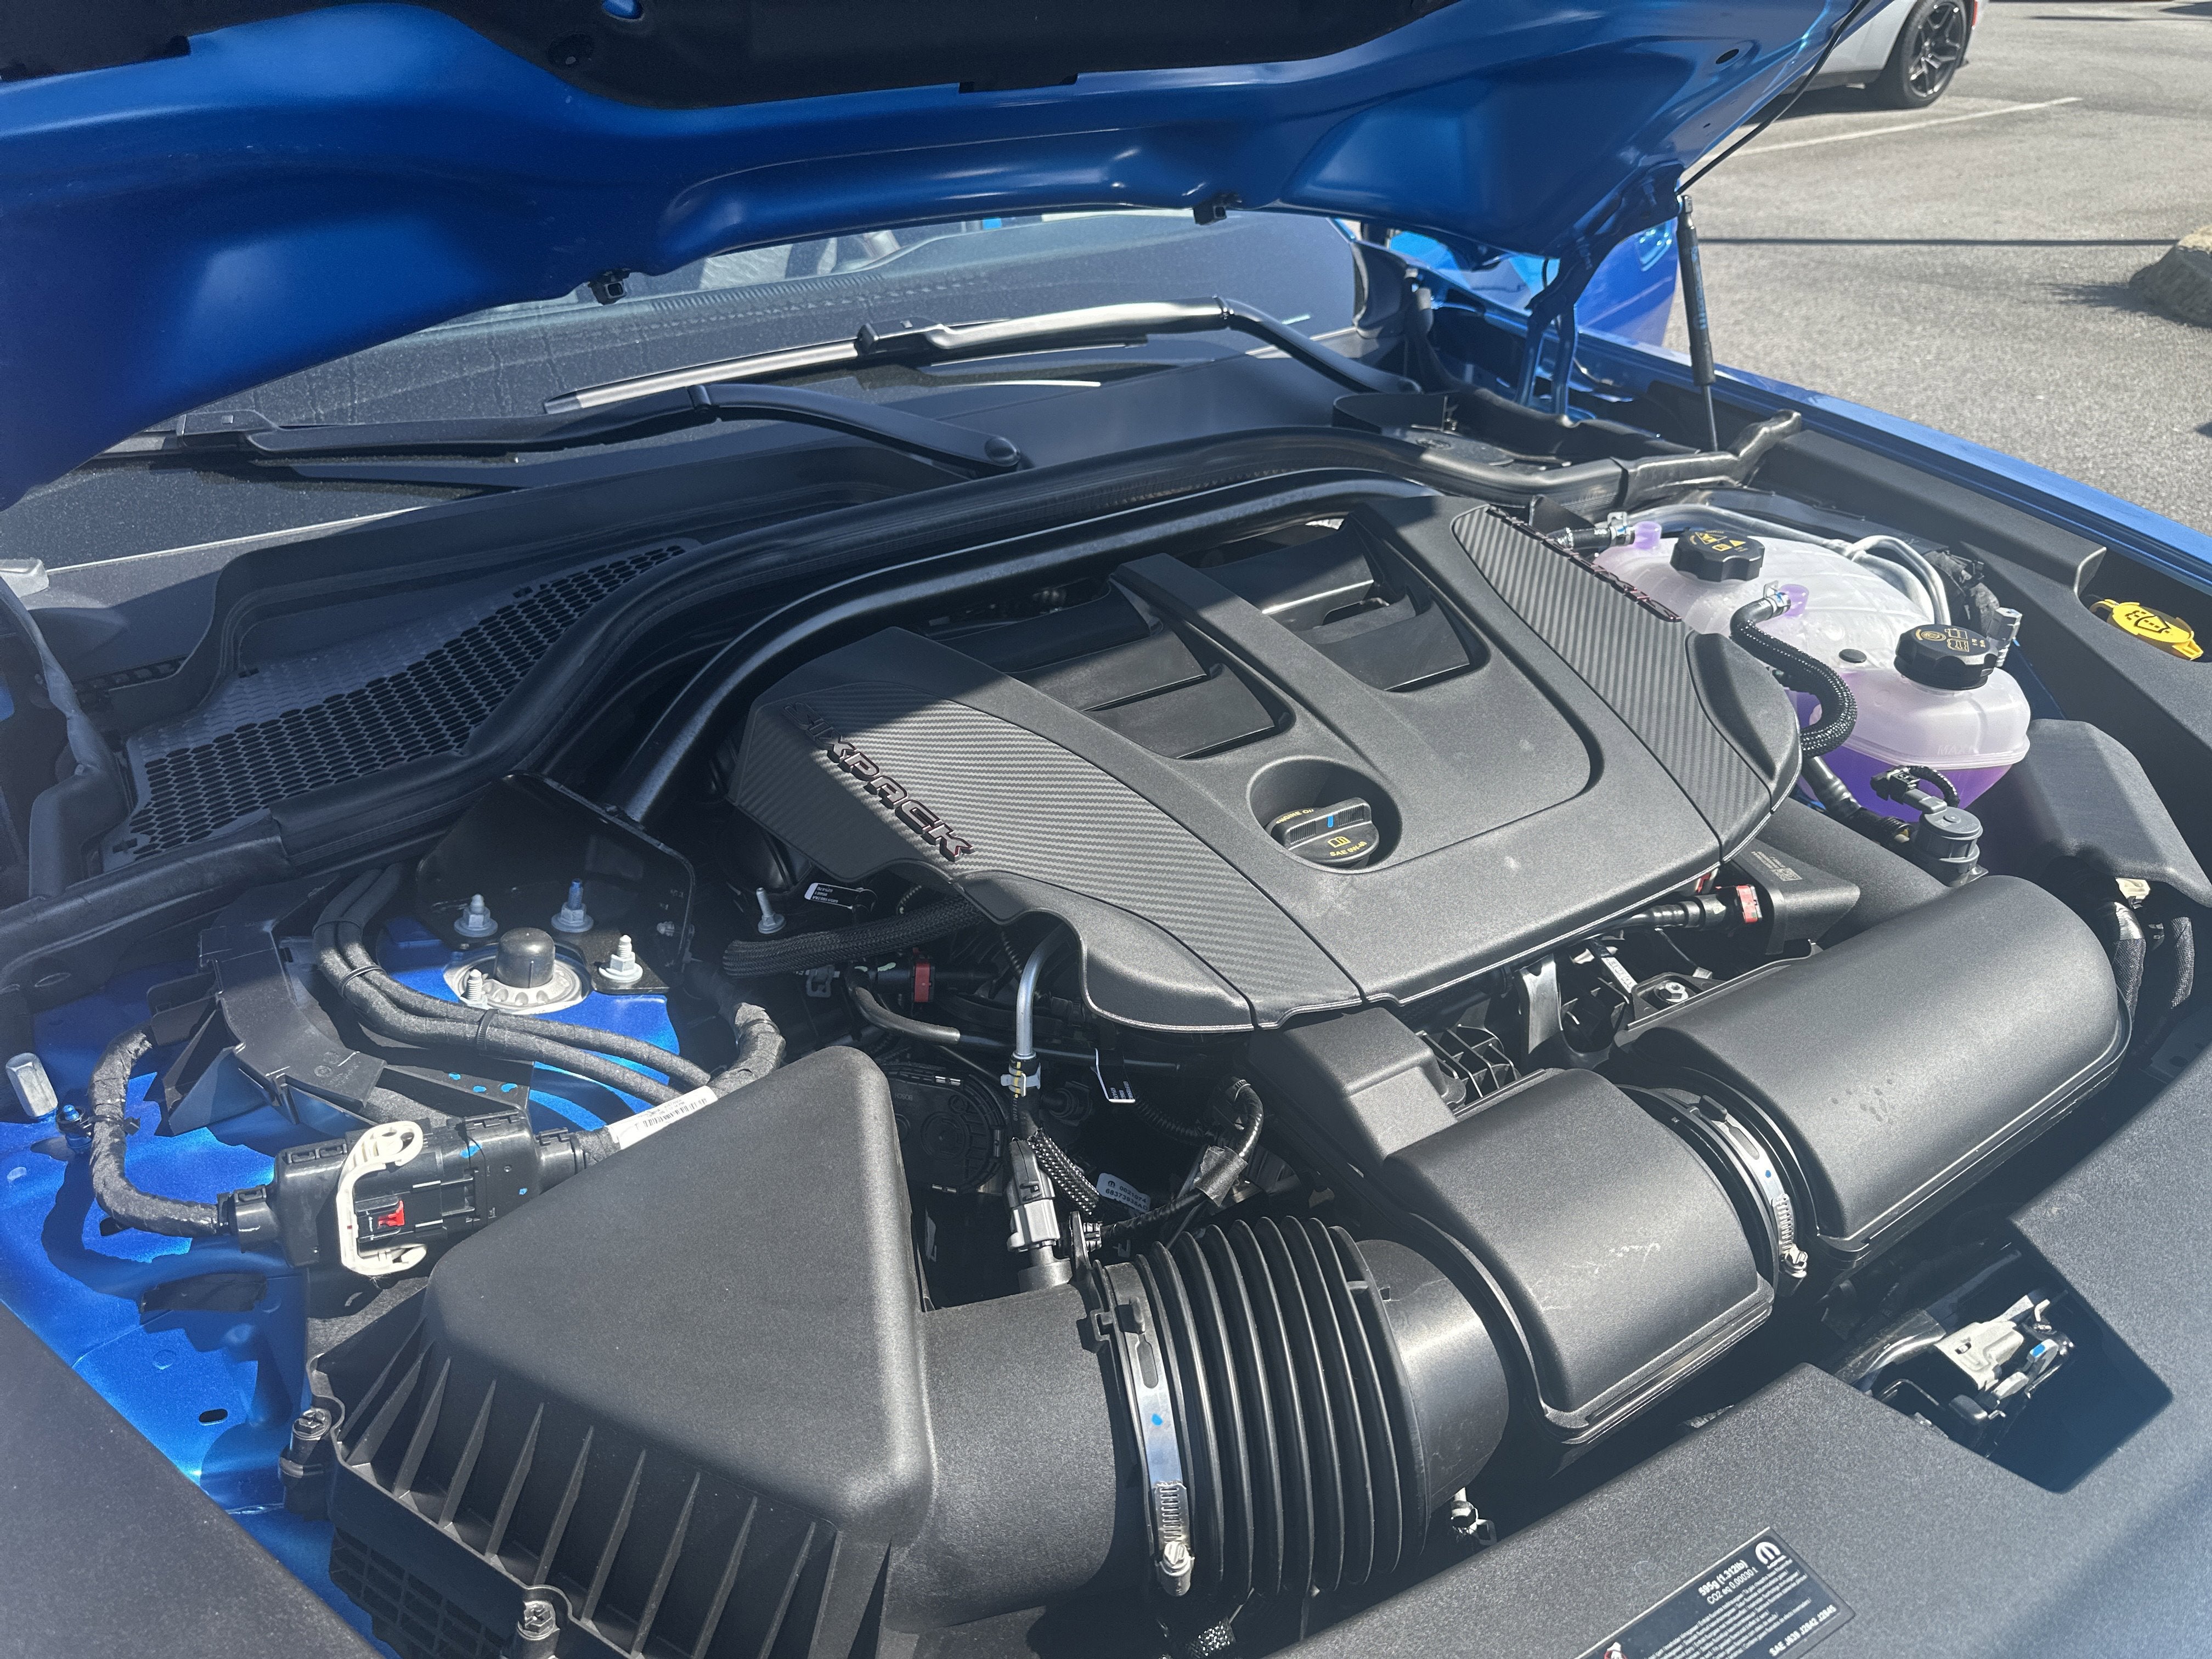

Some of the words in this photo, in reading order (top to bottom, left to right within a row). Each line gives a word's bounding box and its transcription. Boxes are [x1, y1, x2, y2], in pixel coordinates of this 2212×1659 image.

[783, 702, 974, 861] SIXPACK
[1698, 1580, 1720, 1596] 595g
[1707, 1590, 1724, 1605] CO2
[1722, 1586, 1733, 1595] eq
[1769, 1641, 1787, 1657] SAE
